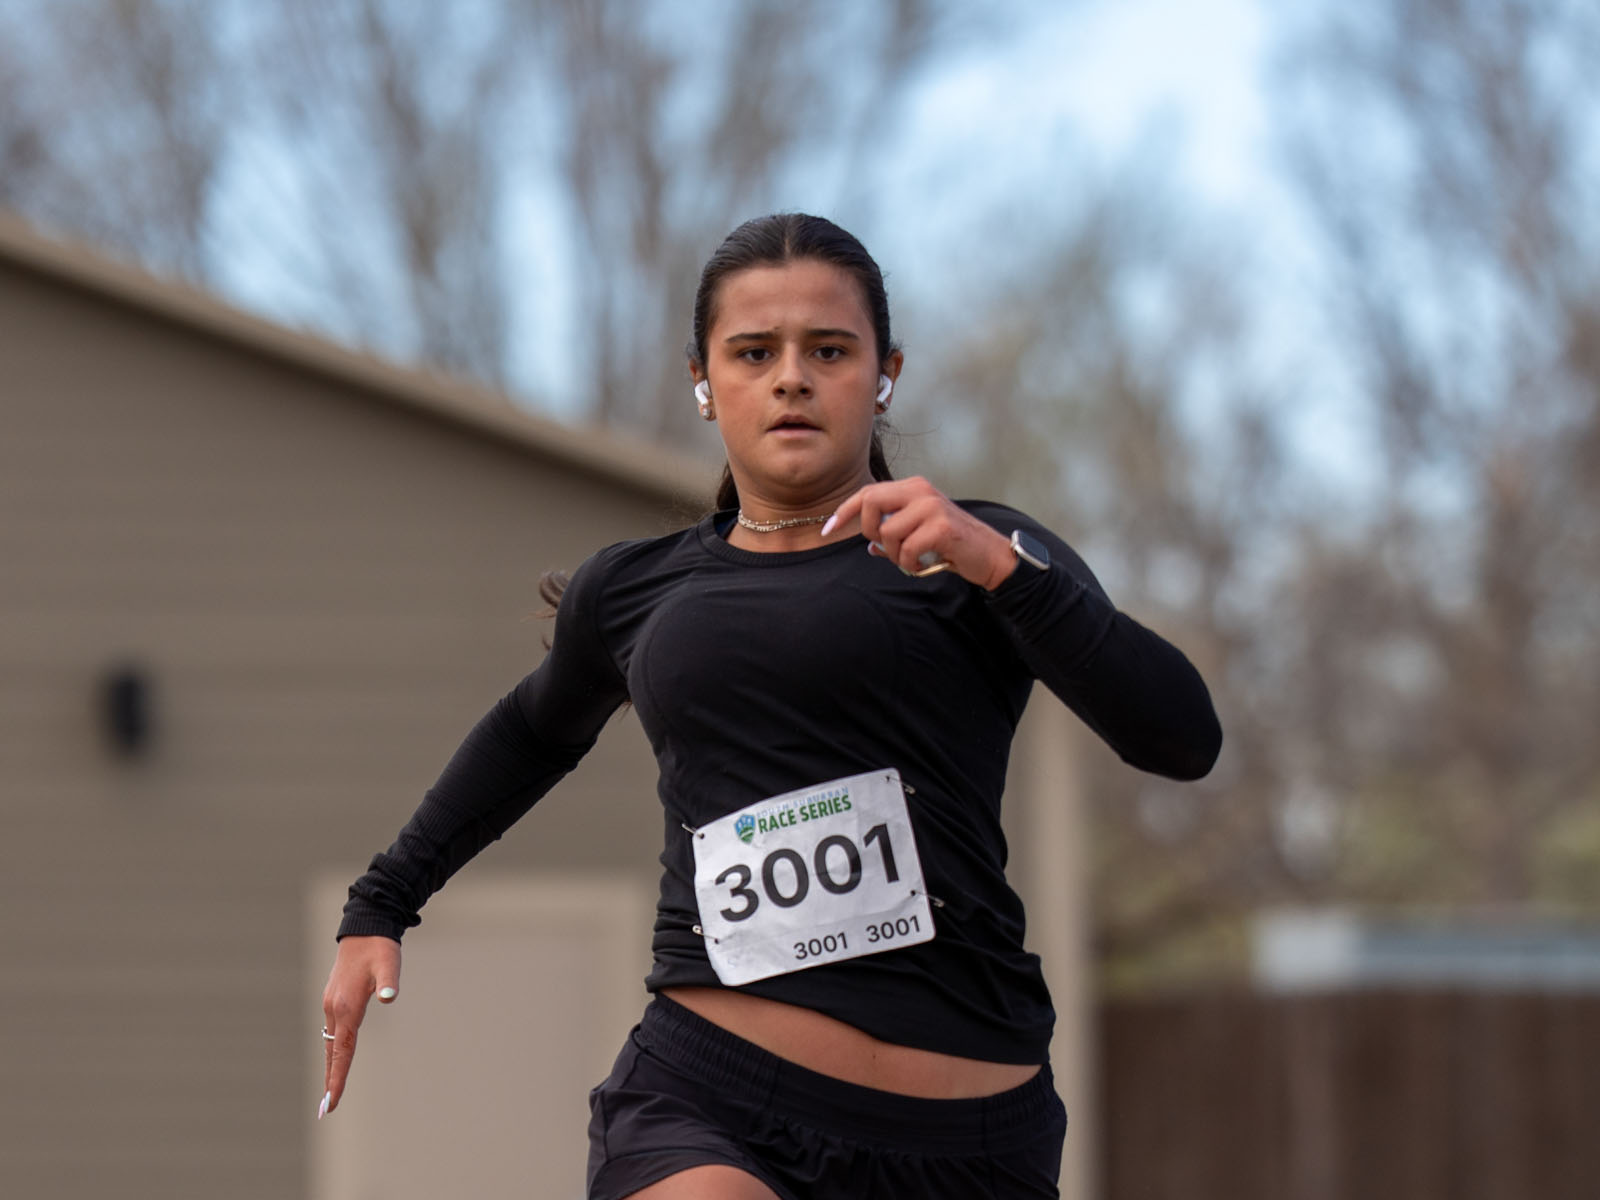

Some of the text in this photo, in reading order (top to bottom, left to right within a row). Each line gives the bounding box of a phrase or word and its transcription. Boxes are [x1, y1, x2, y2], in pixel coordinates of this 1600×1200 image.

[758, 794, 852, 834] RACE SERIES
[715, 823, 900, 923] 3001
[793, 915, 921, 960] 3001 3001
